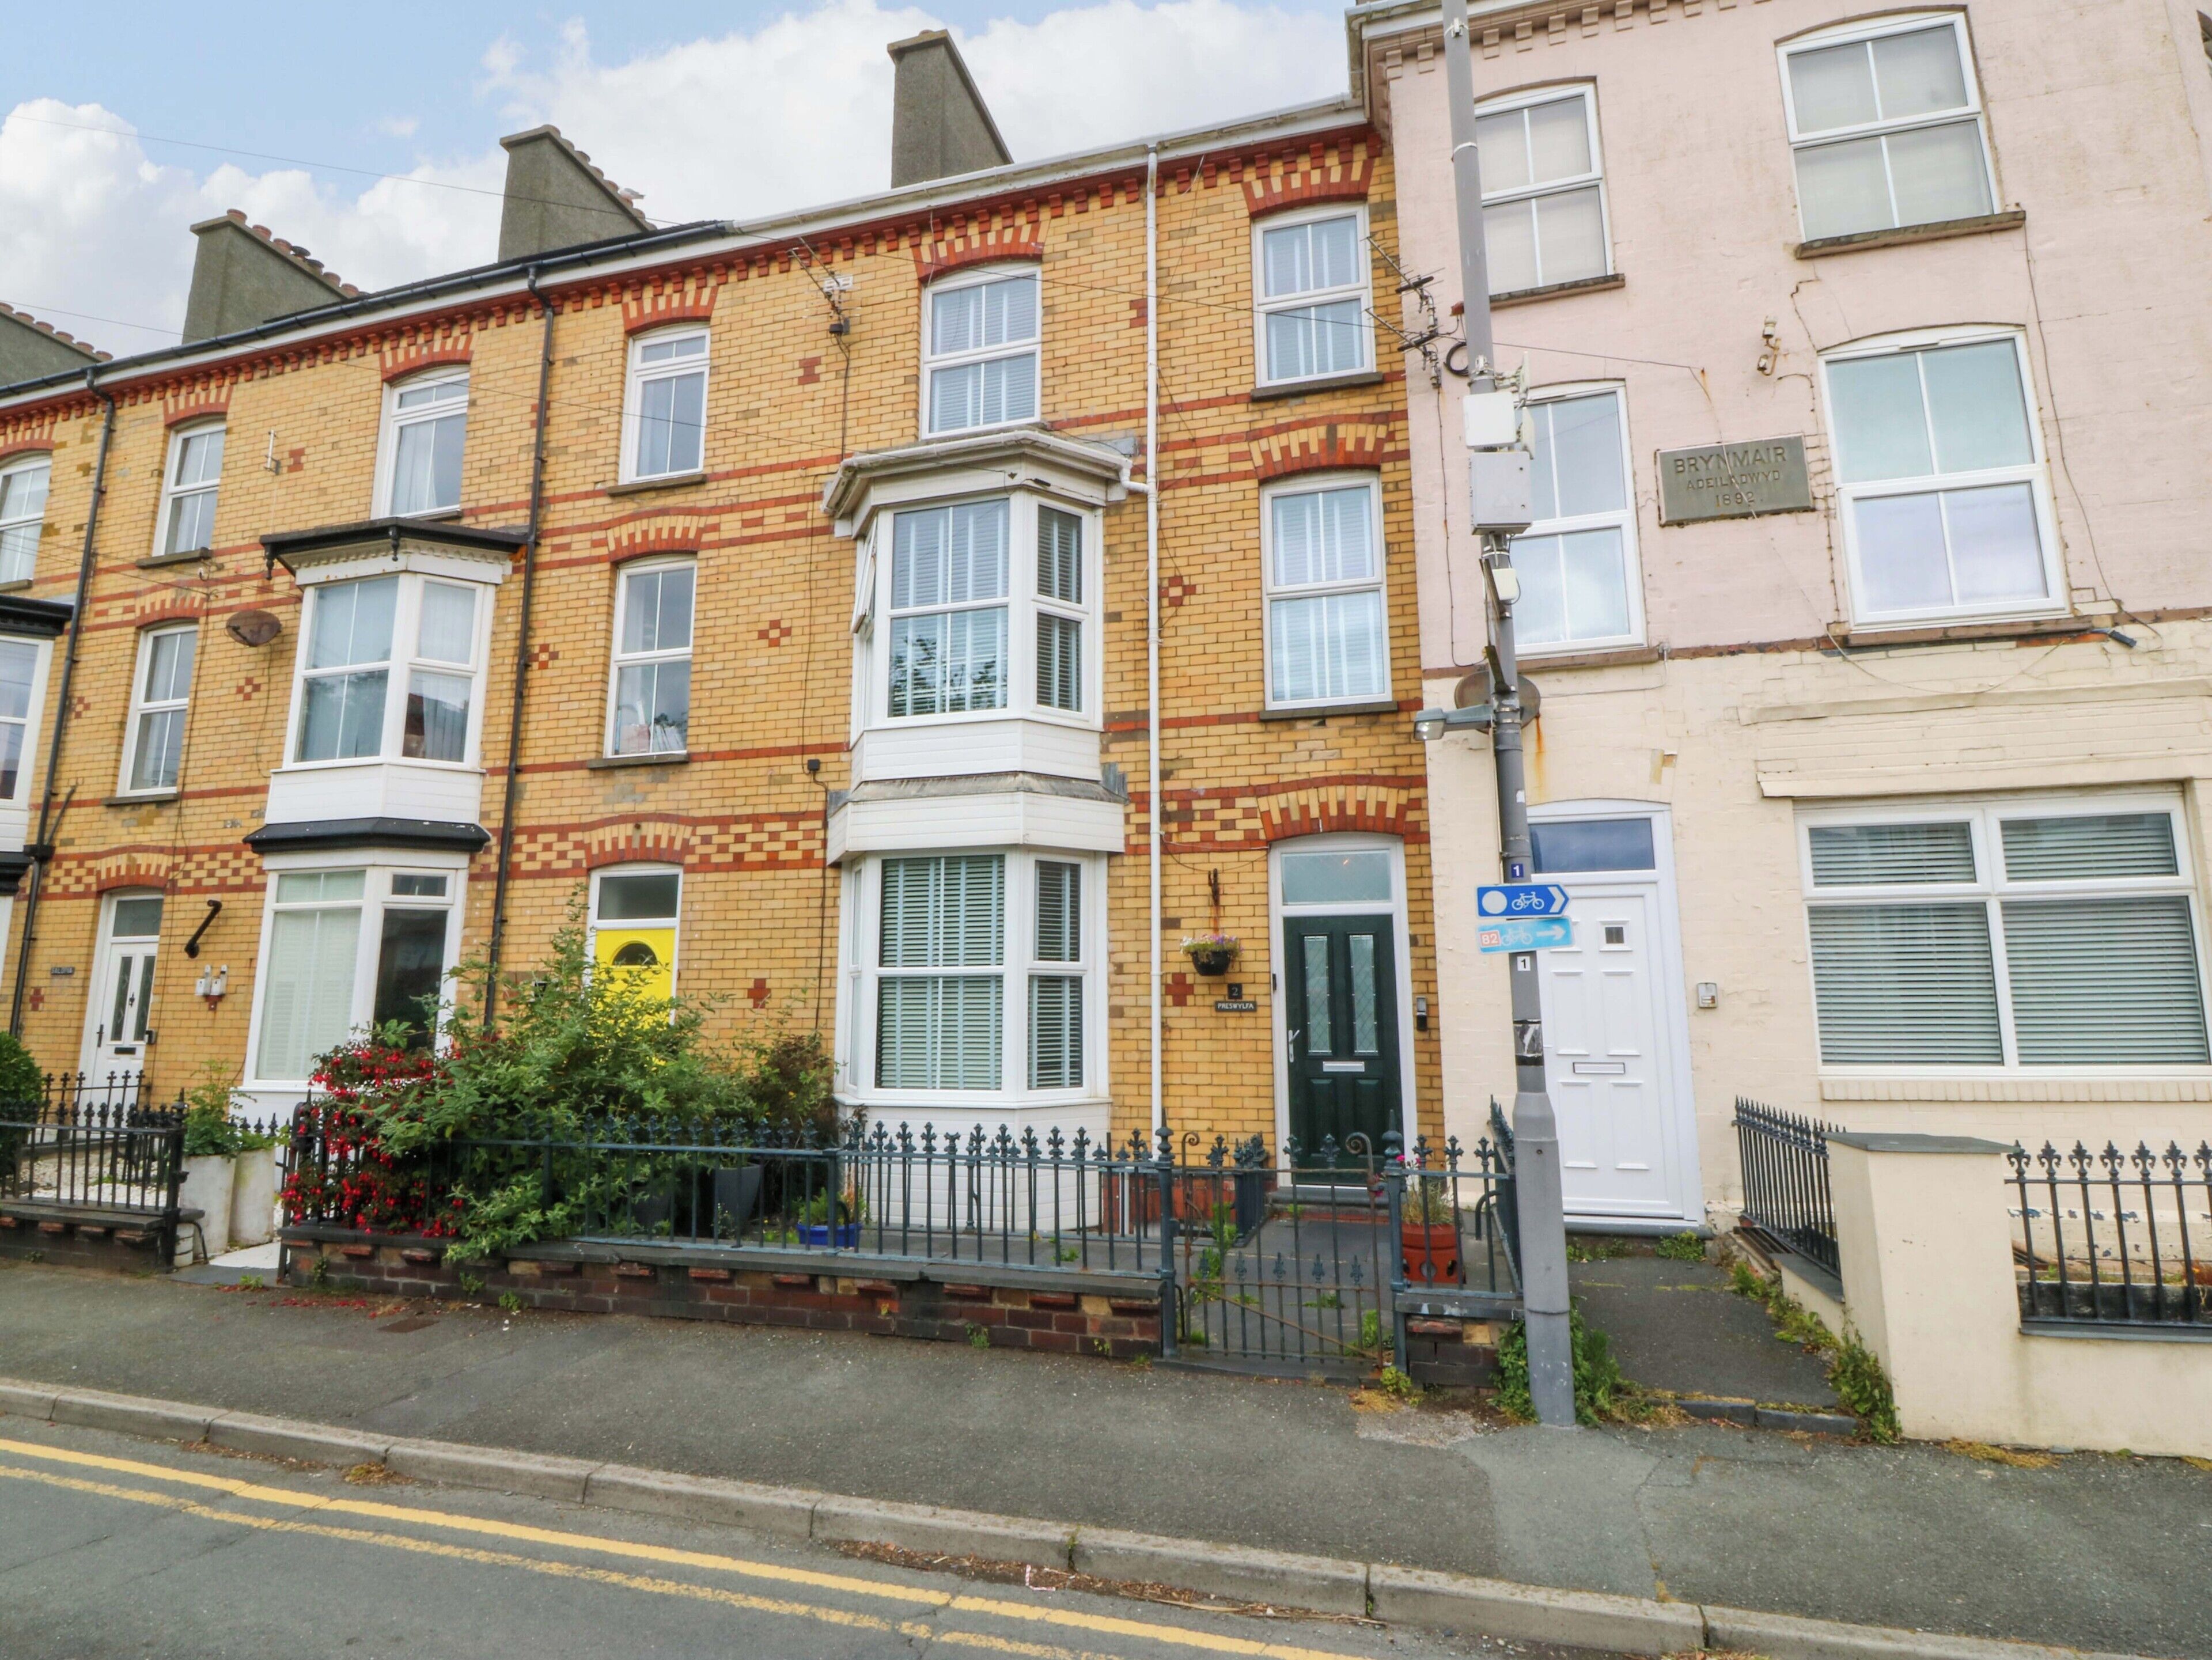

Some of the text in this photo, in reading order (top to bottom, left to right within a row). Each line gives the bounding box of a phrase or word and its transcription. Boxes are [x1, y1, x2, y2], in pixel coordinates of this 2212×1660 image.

[1674, 446, 1786, 473] BRYNMAIR
[1687, 470, 1781, 490] ADEILADWYD
[1513, 865, 1520, 876] 1
[1482, 933, 1498, 945] 82
[1520, 958, 1527, 969] 1
[1232, 987, 1238, 996] 2
